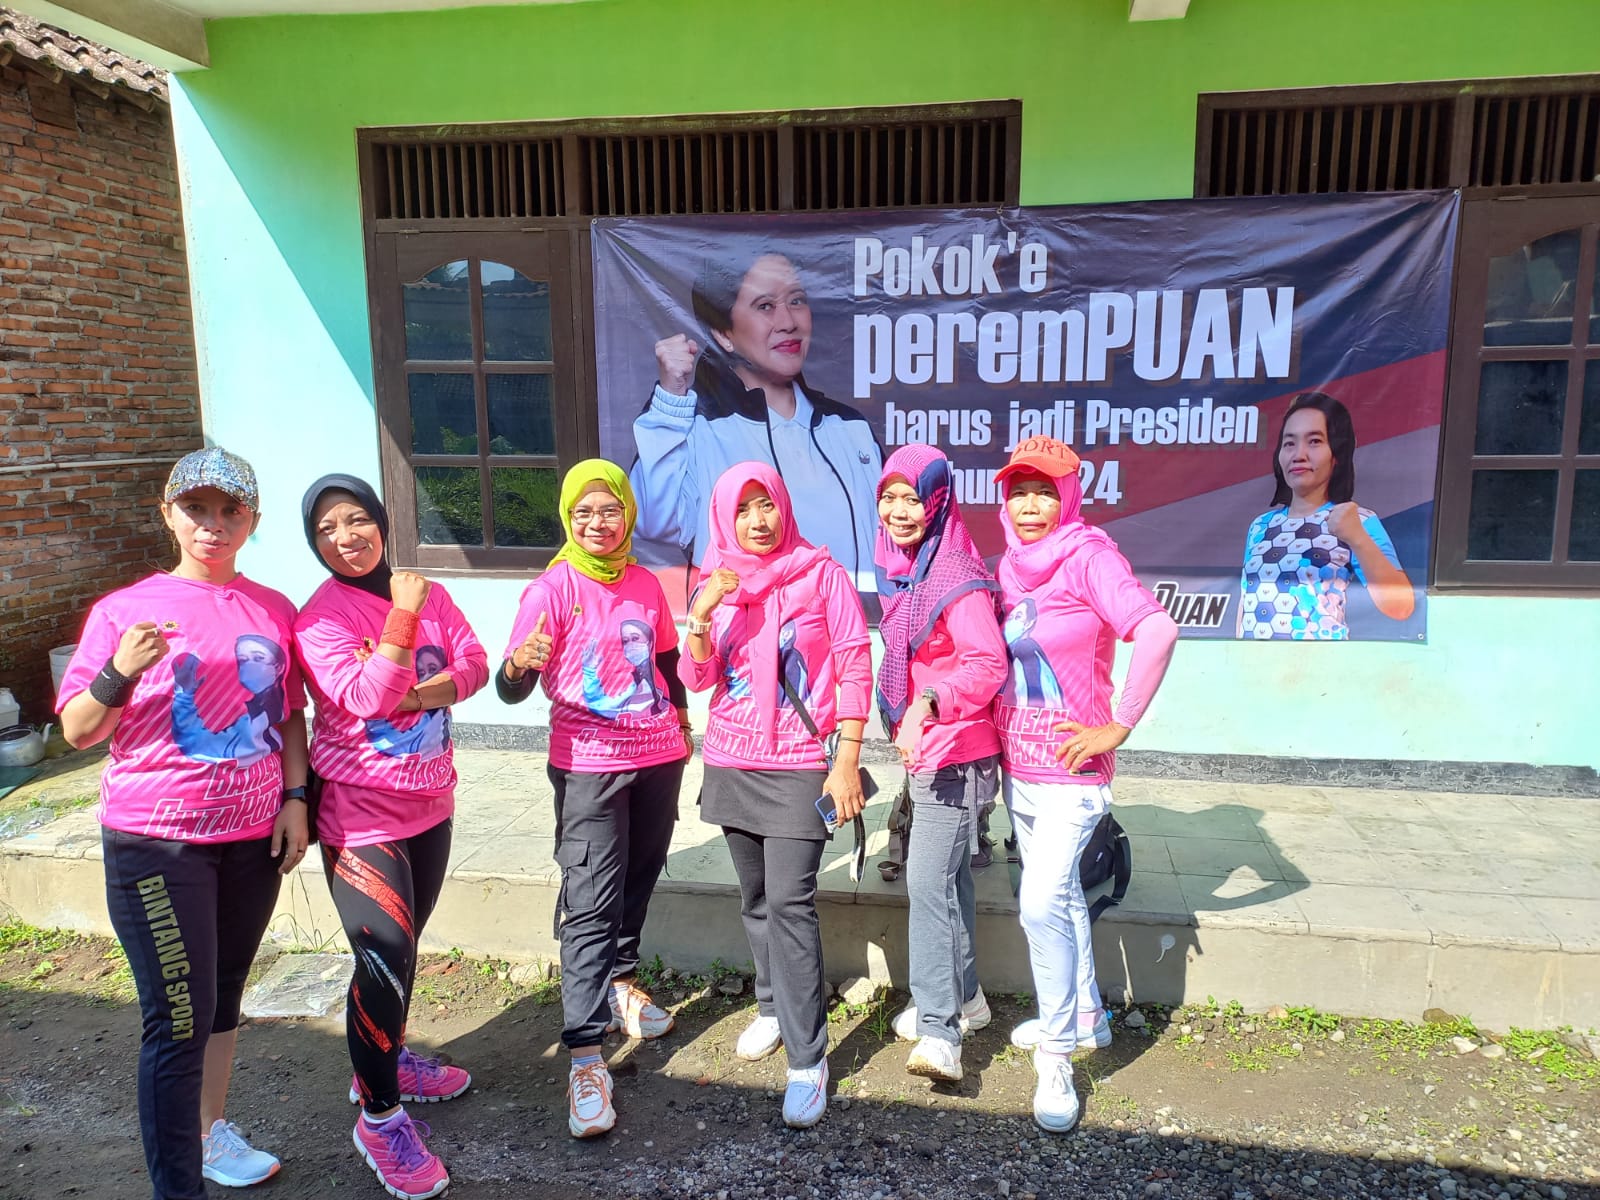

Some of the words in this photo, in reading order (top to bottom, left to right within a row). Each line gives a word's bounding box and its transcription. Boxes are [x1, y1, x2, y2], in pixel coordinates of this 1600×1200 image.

[853, 231, 1048, 297] Pokok'e
[853, 286, 1296, 399] peremPUAN
[885, 401, 992, 446] harus
[1004, 398, 1076, 453] jadi
[1085, 398, 1259, 445] Presiden
[947, 461, 1003, 505] hun
[1079, 460, 1123, 505] 24
[136, 874, 192, 980] BINTANG
[165, 981, 195, 1041] SPORT
